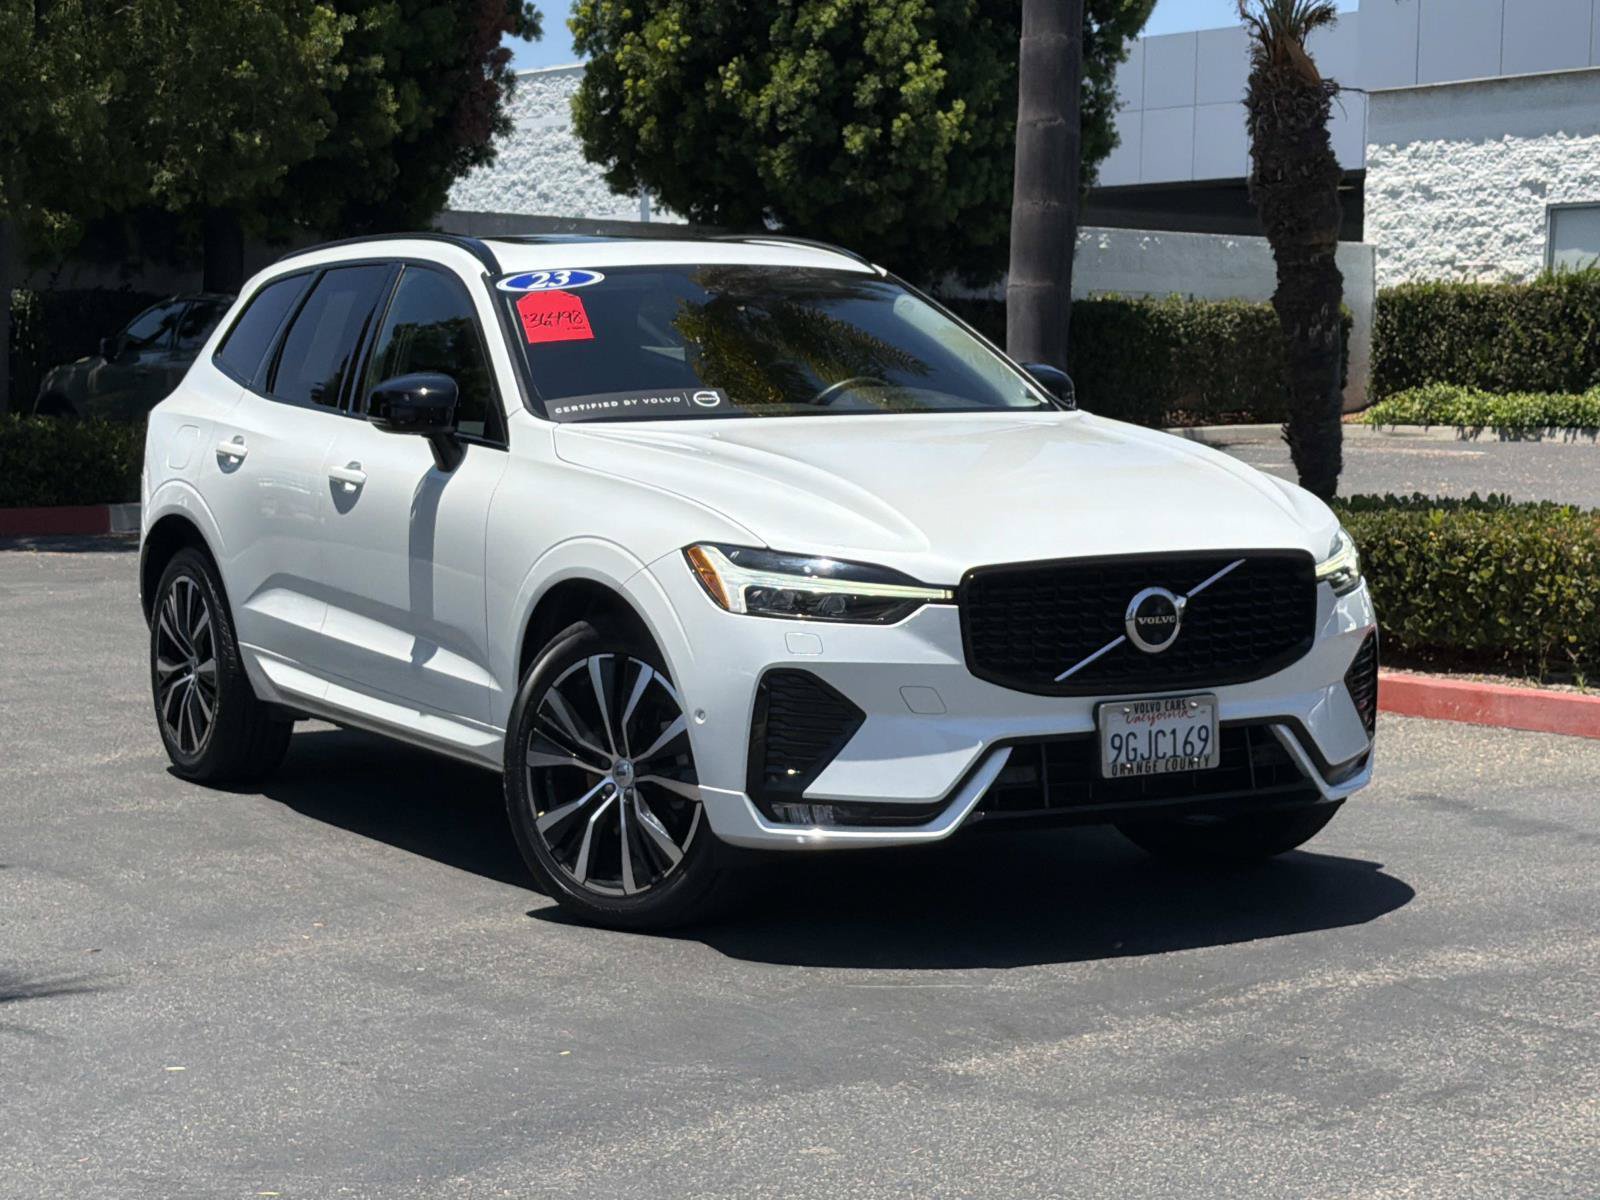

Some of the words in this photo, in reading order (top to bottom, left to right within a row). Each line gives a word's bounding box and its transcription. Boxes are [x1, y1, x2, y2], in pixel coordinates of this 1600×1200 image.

[531, 271, 572, 289] 23
[554, 401, 619, 414] CERTIFIED
[642, 396, 681, 404] VOLVO
[1137, 615, 1176, 625] VOLVO
[1133, 702, 1161, 713] VOLVO
[1164, 699, 1187, 711] CARS
[1110, 724, 1210, 764] 9GJC169
[1111, 761, 1158, 777] ORANGE
[1165, 755, 1210, 772] COUNTY
